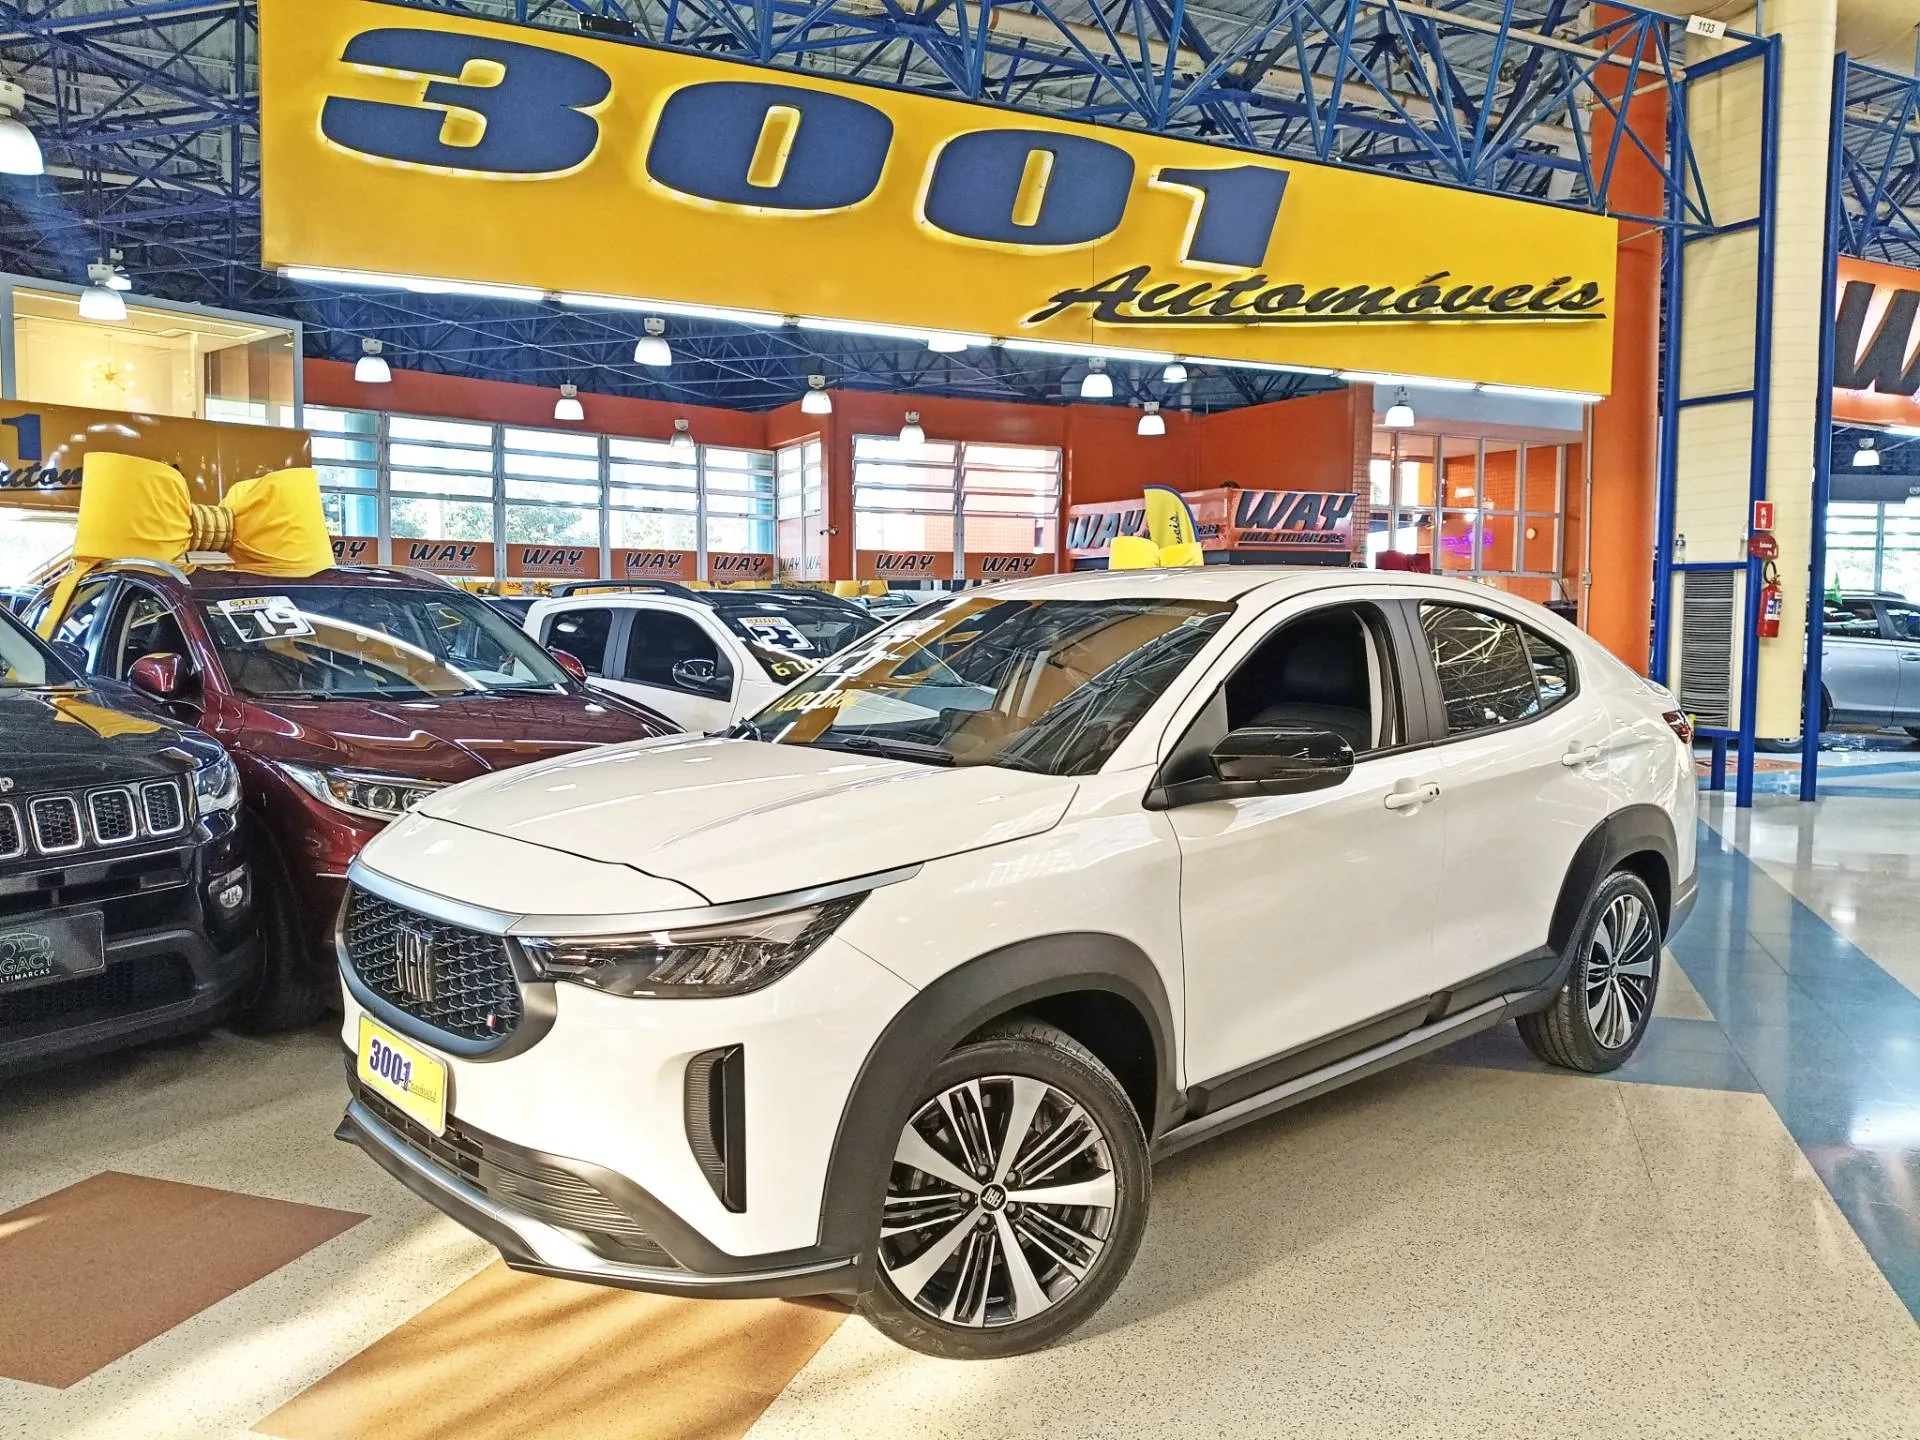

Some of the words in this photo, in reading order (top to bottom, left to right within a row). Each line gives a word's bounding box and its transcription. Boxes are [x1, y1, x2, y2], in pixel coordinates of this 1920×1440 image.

[1697, 20, 1716, 34] 1133
[320, 27, 1290, 268] 3001
[1025, 265, 1607, 325] Automóveis
[1234, 491, 1358, 531] WAY
[1066, 509, 1146, 550] WAY
[332, 540, 368, 559] AY
[409, 543, 478, 562] WAY
[521, 547, 585, 566] WAY
[625, 552, 683, 570] WAY
[713, 556, 766, 571] WAY
[875, 554, 935, 570] WAY
[982, 557, 1037, 572] WAY
[254, 607, 311, 636] 19
[752, 625, 811, 650] 23
[0, 968, 50, 983] LTIMARCAS
[369, 1038, 412, 1086] 3001
